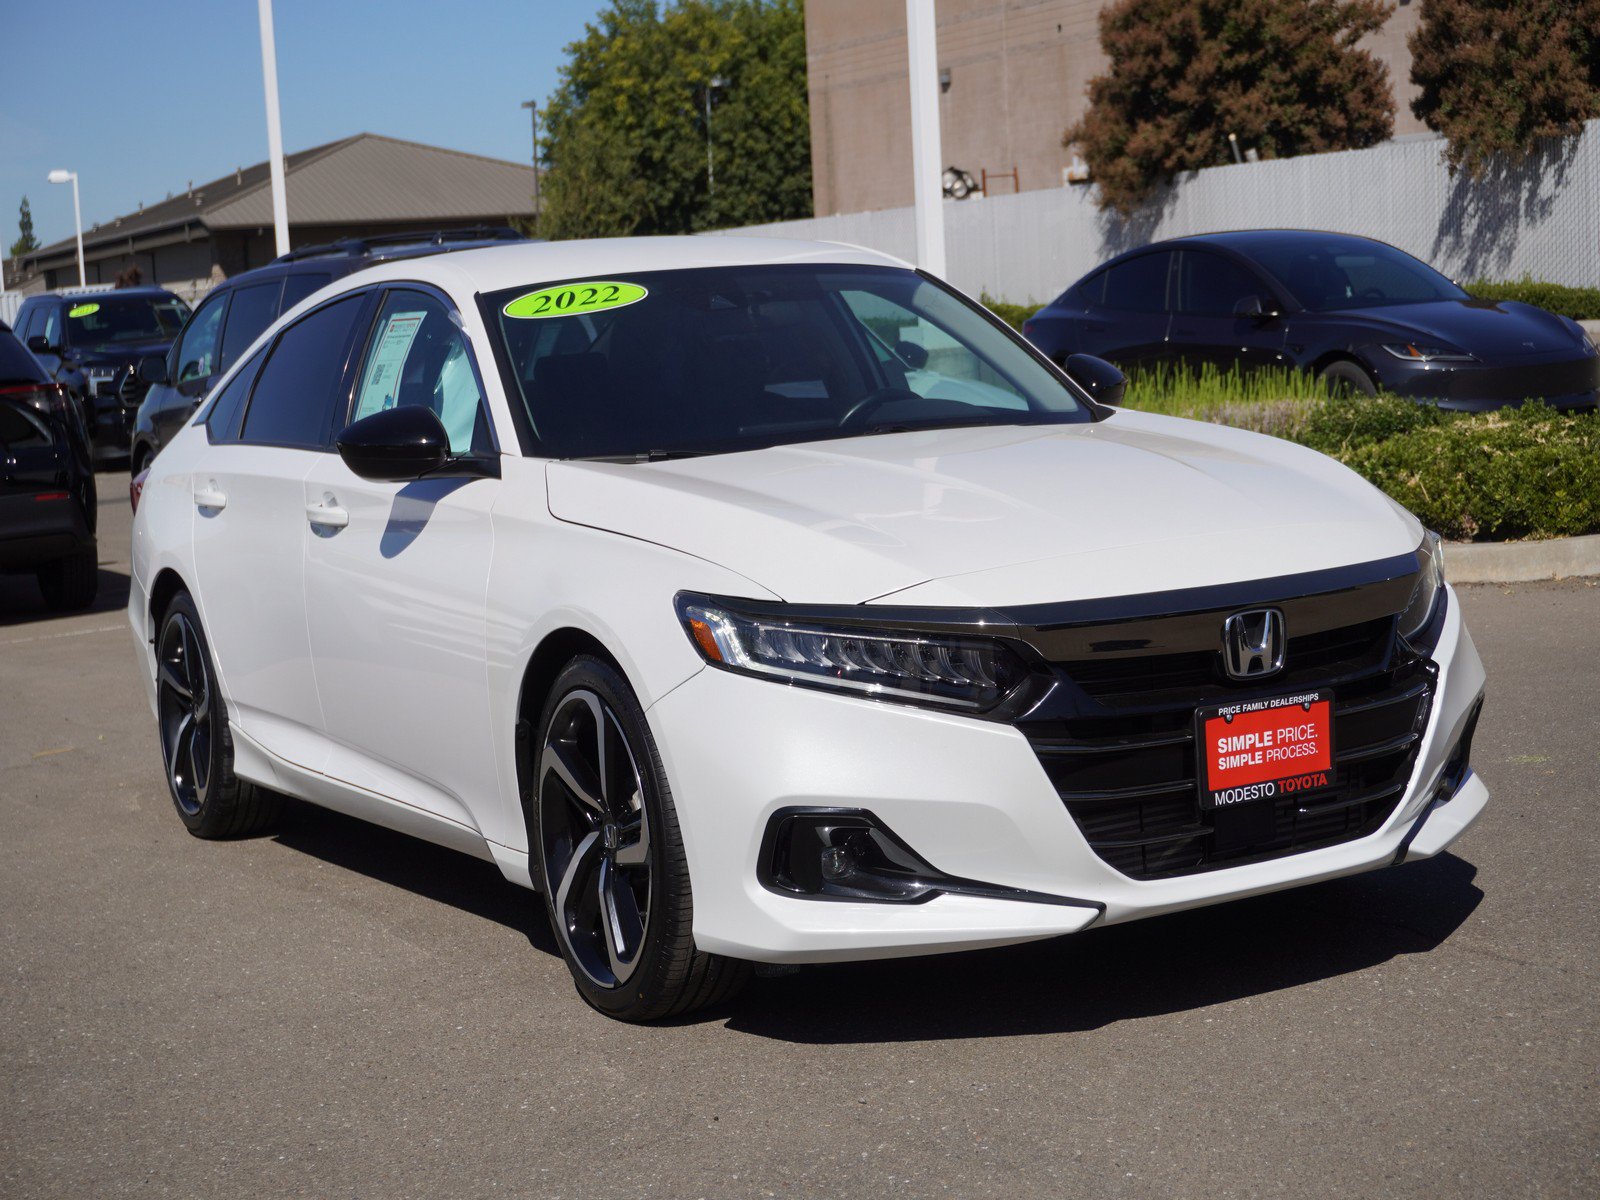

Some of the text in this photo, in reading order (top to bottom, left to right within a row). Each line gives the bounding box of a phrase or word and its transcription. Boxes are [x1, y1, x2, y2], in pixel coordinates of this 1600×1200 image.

[532, 285, 620, 315] 2022
[1218, 693, 1319, 716] PRICE FAMILY DEALERSHIPS
[1217, 723, 1318, 754] SIMPLE PRICE.
[1218, 742, 1319, 770] SIMPLE PROCESS.
[1214, 773, 1328, 806] MODESTO TOYOTA
